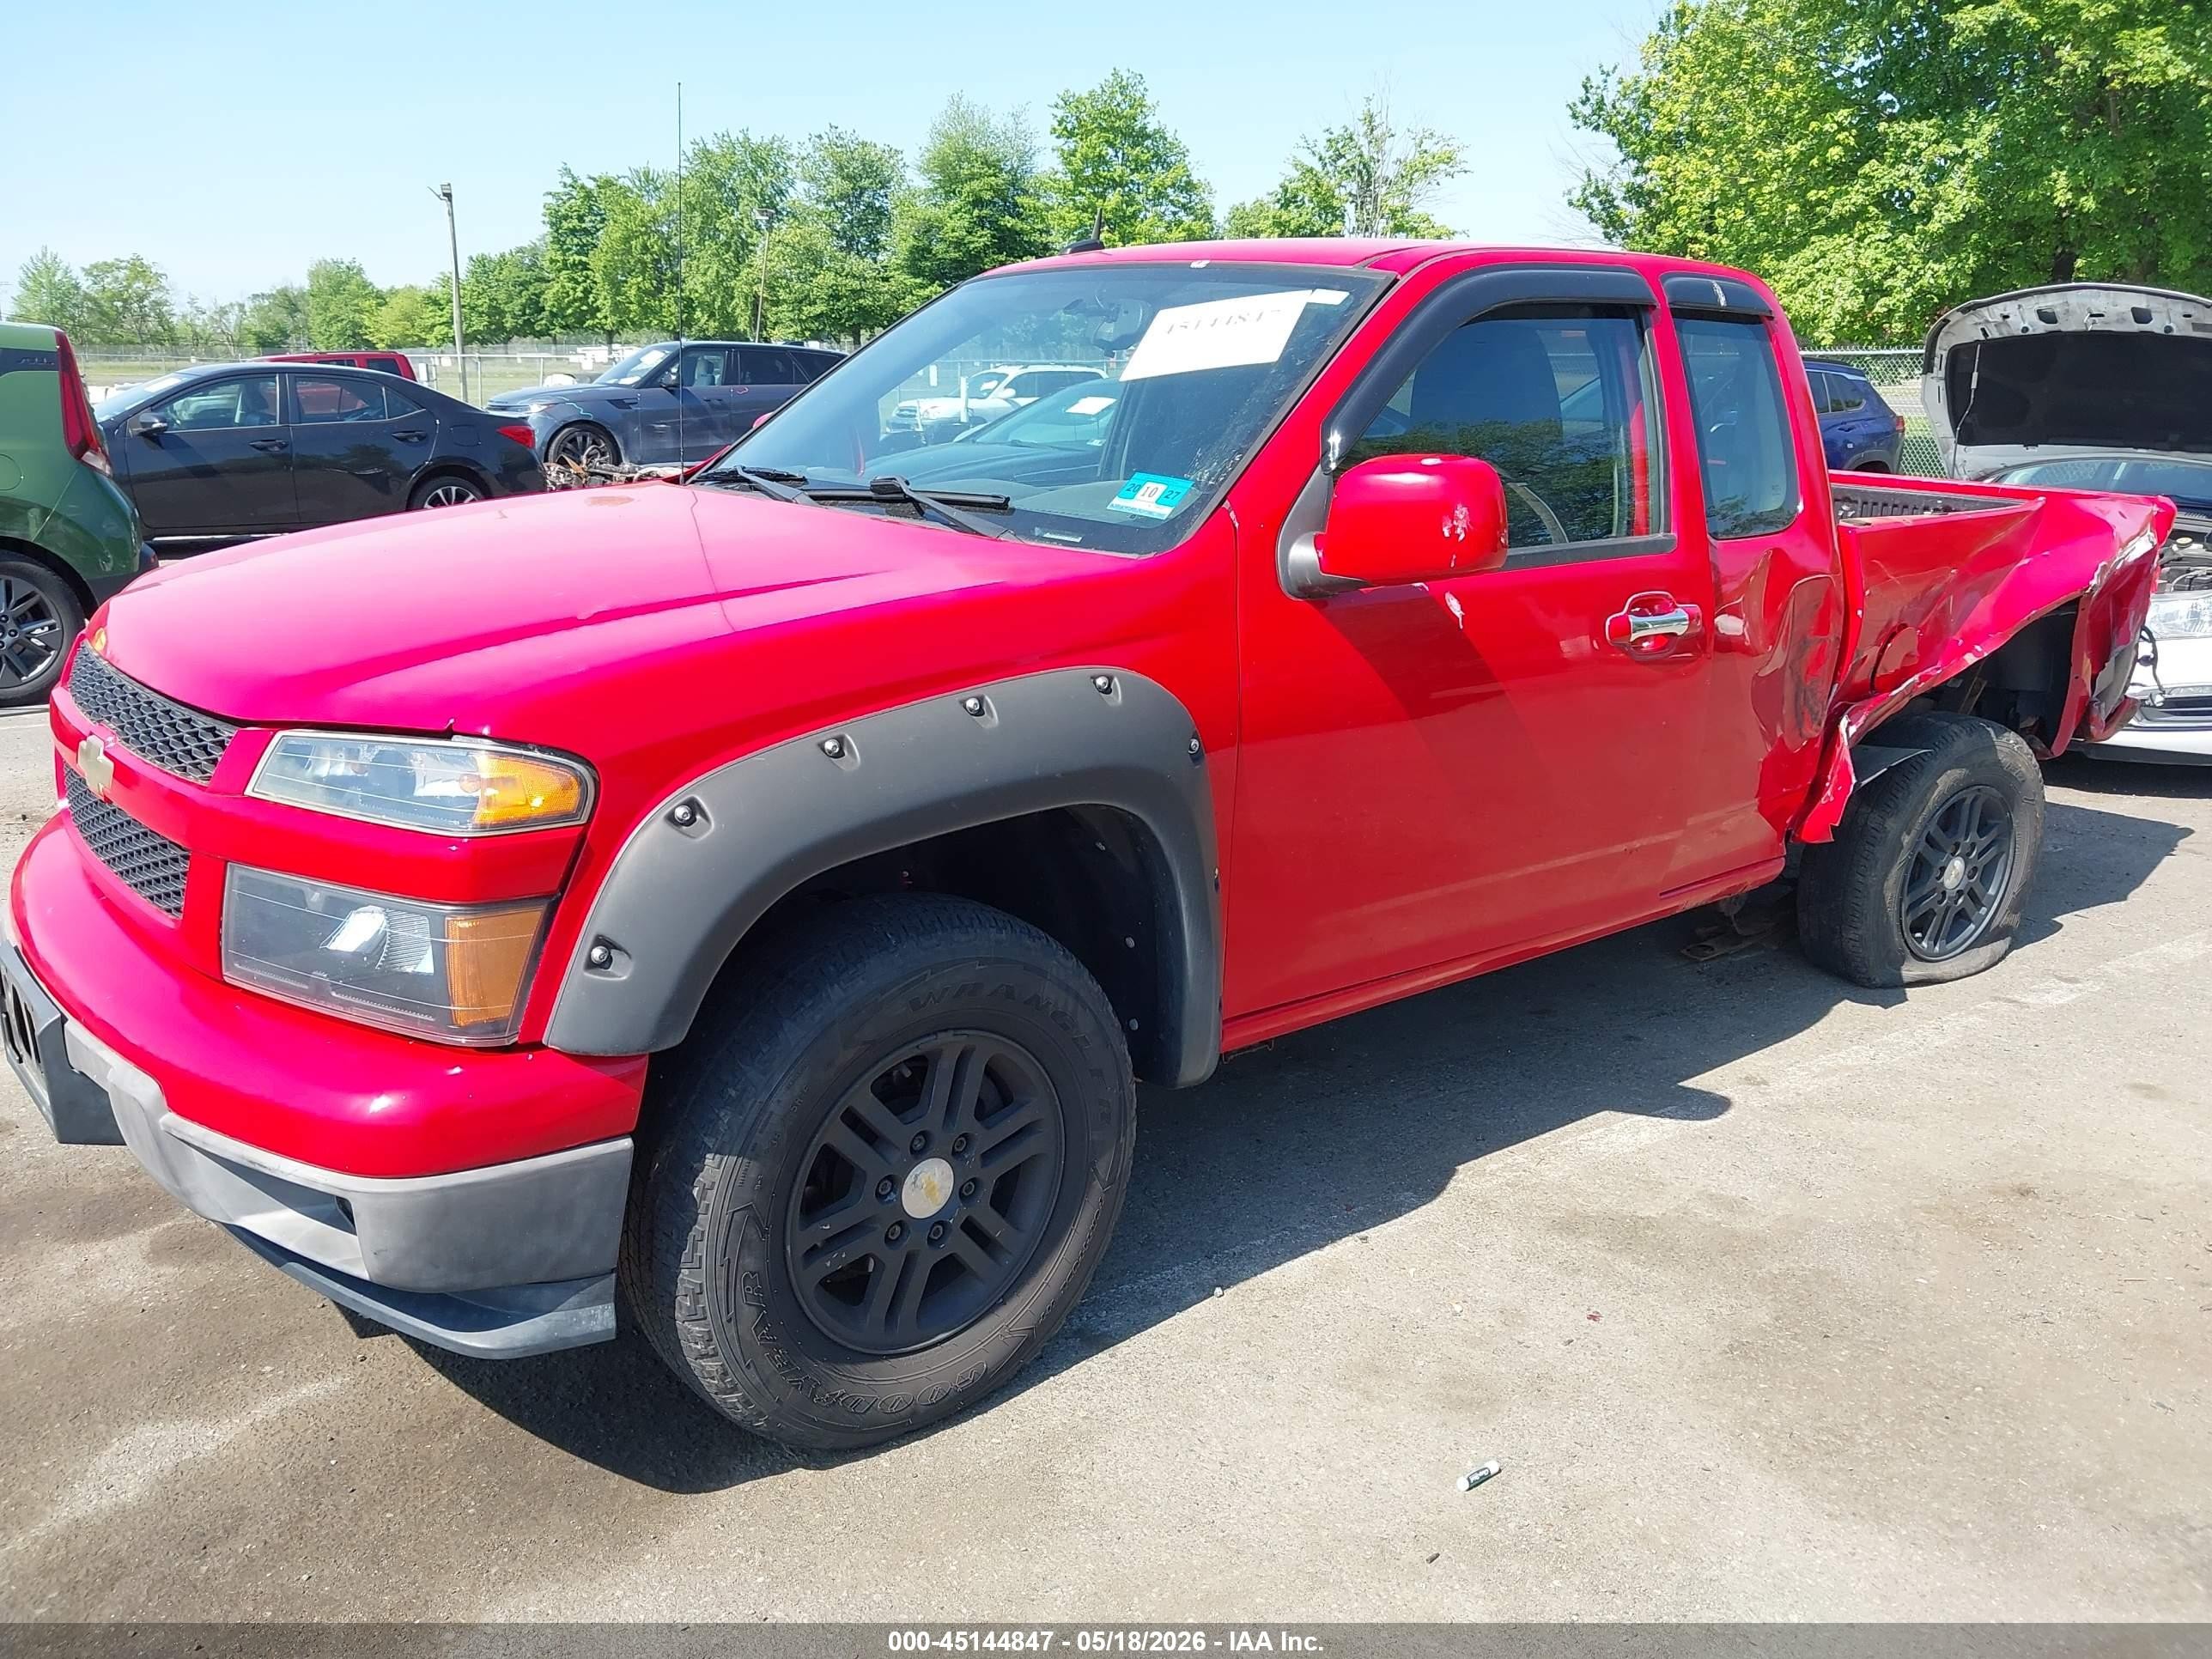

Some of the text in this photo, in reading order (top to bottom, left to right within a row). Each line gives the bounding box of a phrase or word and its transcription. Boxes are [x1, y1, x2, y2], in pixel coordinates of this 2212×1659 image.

[1125, 483, 1182, 500] 20 10 27
[741, 1271, 987, 1414] GOODYEAR
